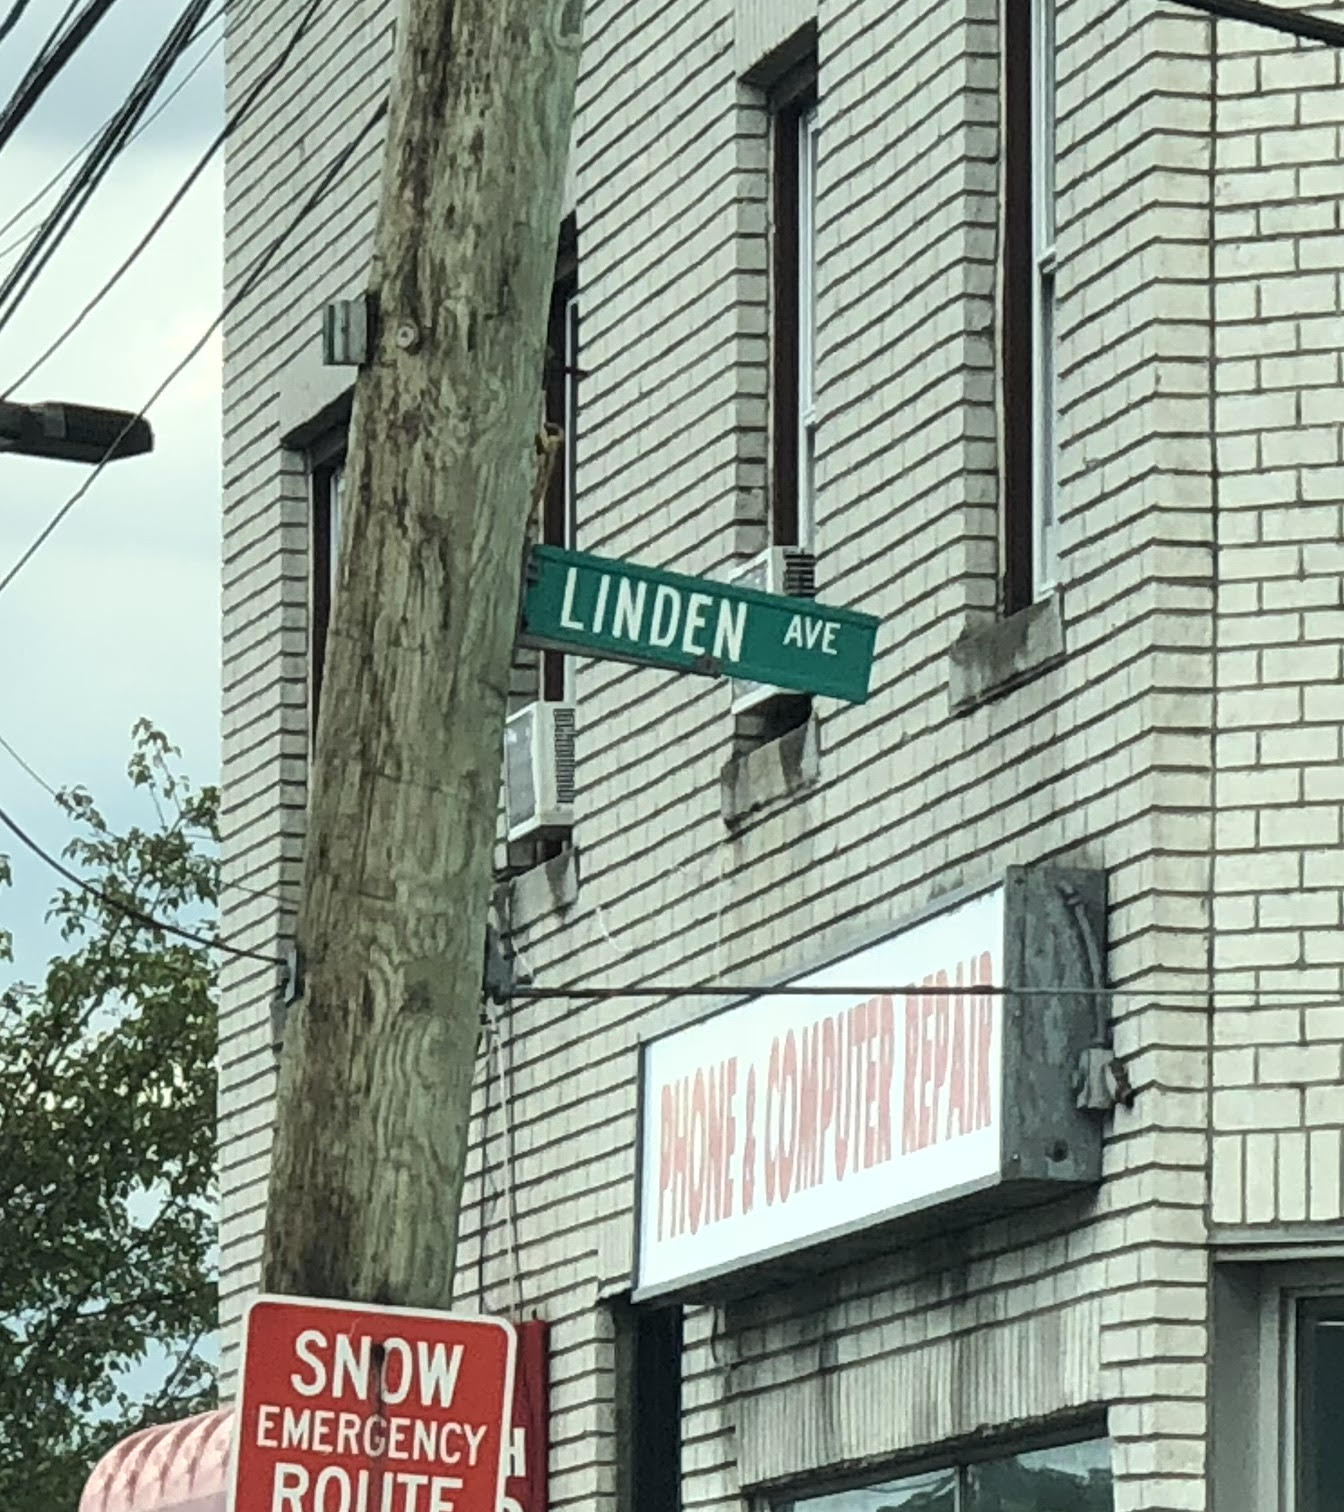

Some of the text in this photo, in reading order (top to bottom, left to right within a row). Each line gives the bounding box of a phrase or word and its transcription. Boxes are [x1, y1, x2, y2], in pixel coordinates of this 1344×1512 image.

[560, 567, 841, 662] LINDEN AVE
[657, 950, 994, 1242] PHONE & COMPUTER REPAIR
[290, 1329, 465, 1408] SNOW
[255, 1404, 487, 1466] EMERGENCY
